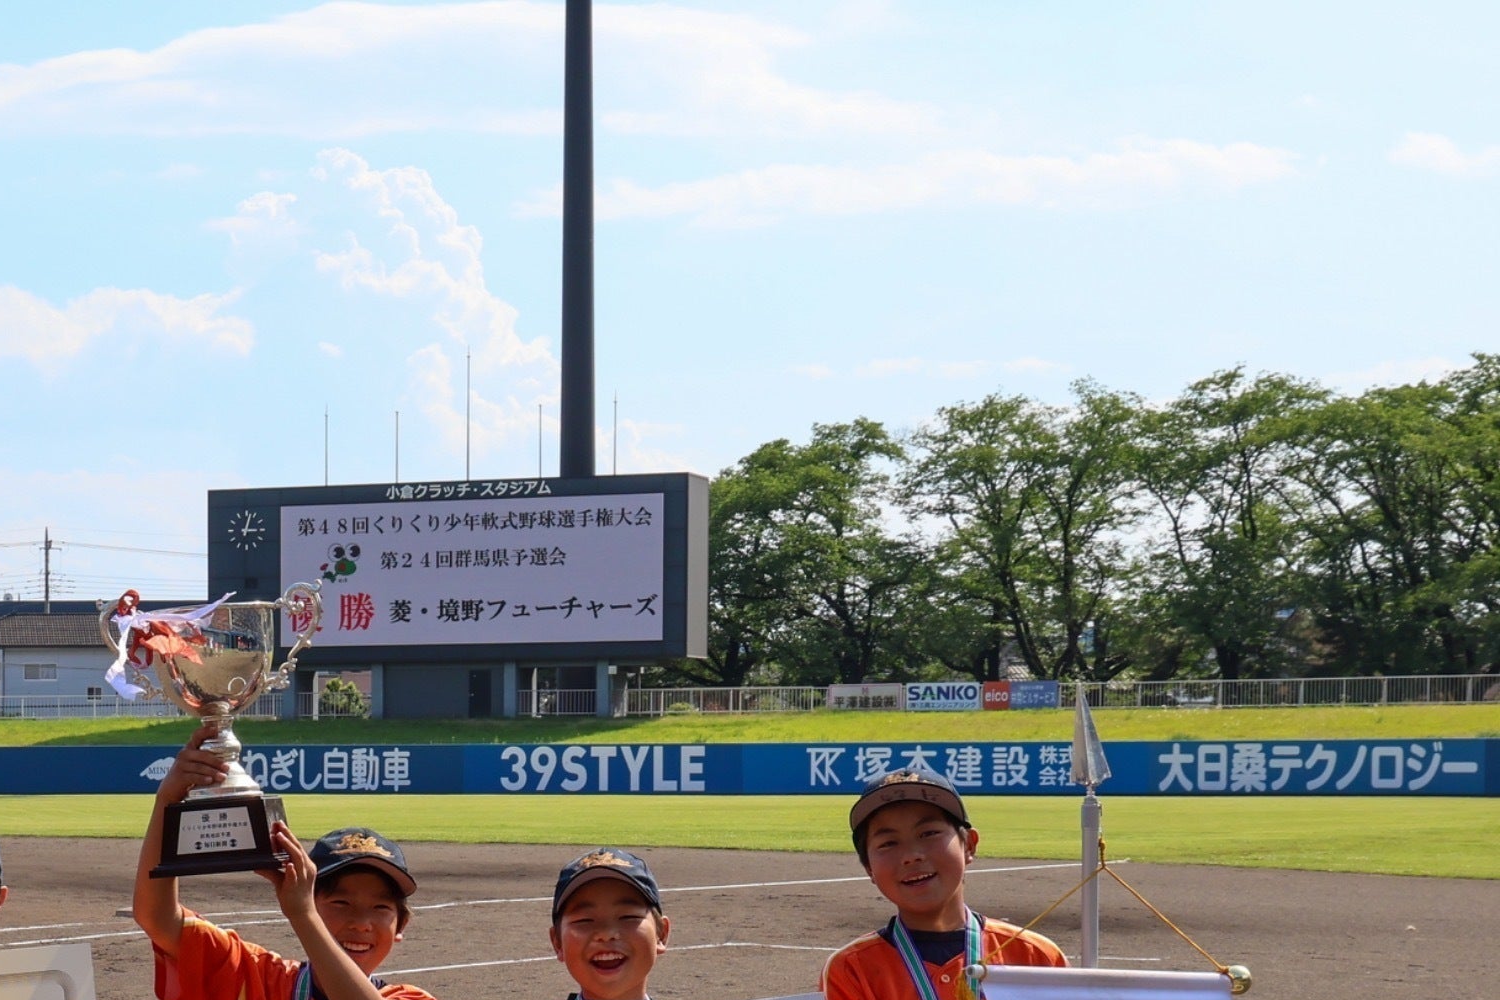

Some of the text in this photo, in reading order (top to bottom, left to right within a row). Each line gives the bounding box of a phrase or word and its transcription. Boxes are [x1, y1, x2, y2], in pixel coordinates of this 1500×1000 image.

[385, 480, 552, 500] 小倉クラッチ・スタジアム
[389, 593, 658, 624] 菱・境野フューチャーズ
[908, 685, 977, 701] SANKO
[243, 748, 411, 791] ねぎし自動車
[500, 745, 706, 792] 39STYLE
[1158, 743, 1479, 793] 大日桑テクノロジー
